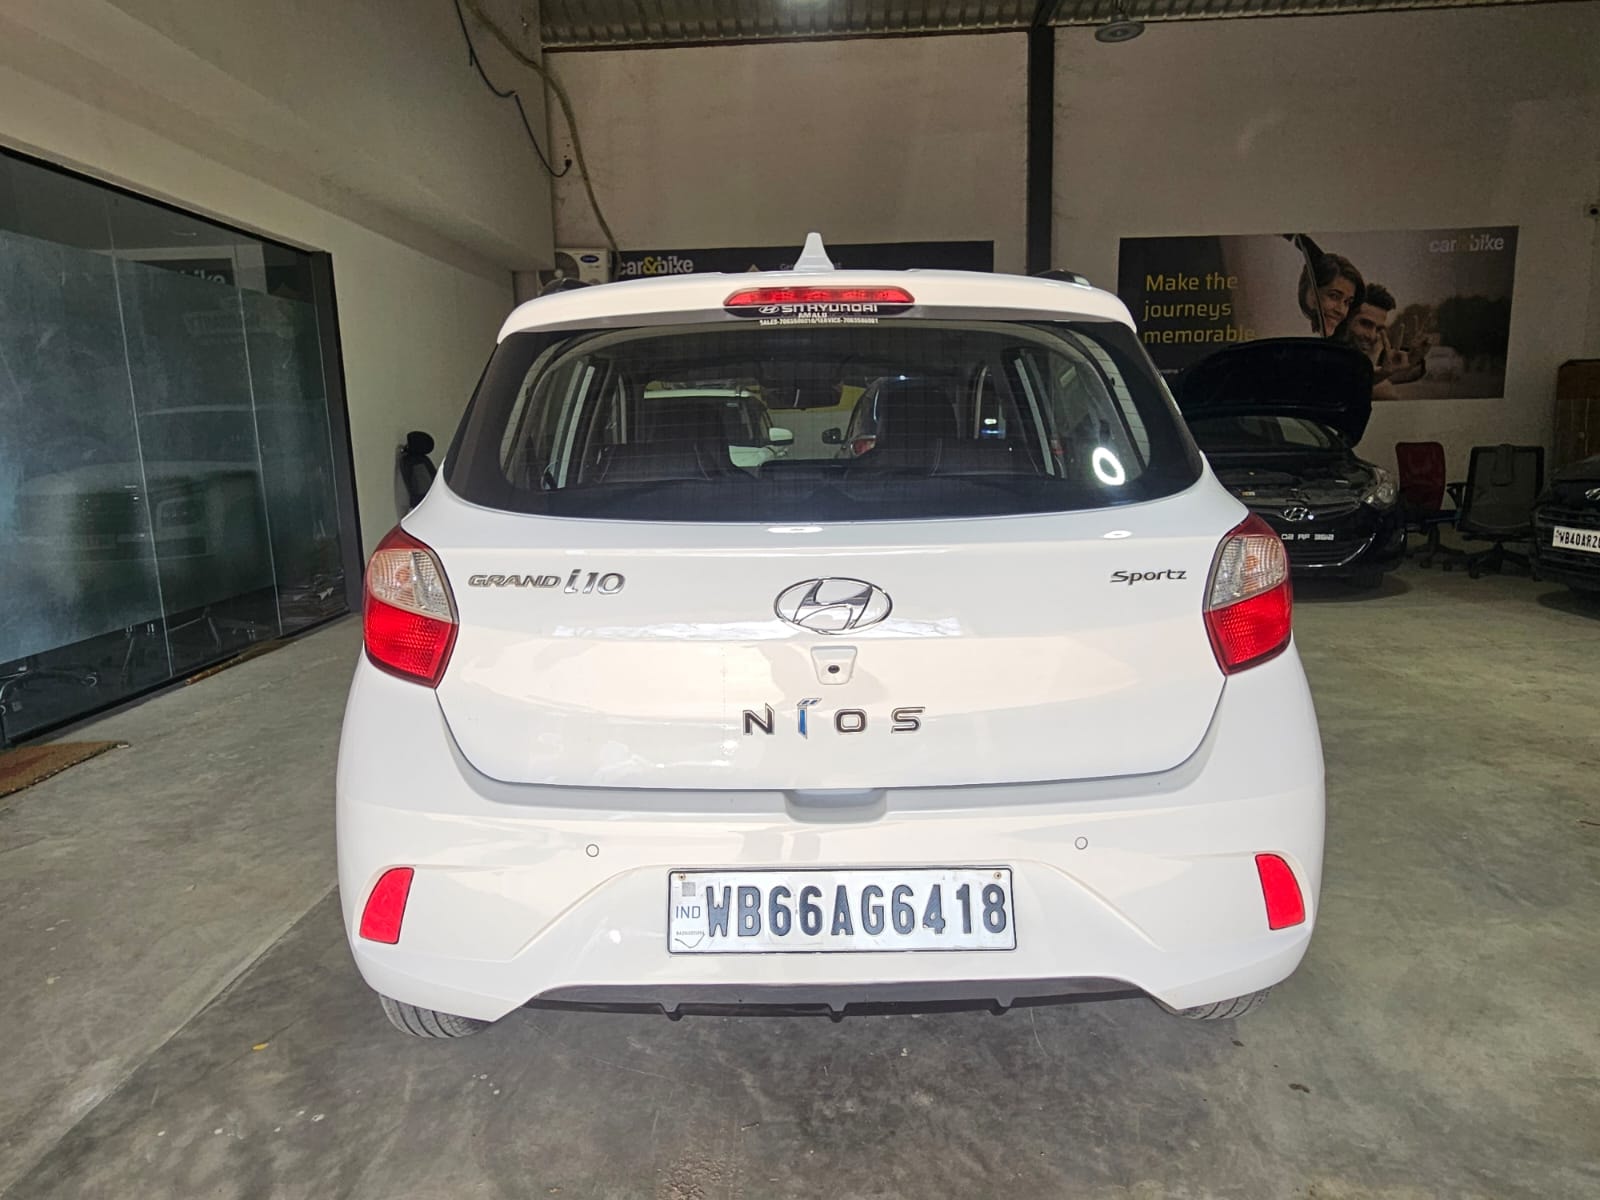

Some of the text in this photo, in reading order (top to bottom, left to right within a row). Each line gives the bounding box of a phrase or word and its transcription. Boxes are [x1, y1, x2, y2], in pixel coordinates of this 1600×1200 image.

[1428, 234, 1505, 253] carbike
[1146, 272, 1239, 291] Make the
[807, 303, 878, 312] HYUNDAI
[1143, 300, 1232, 321] journeys
[1144, 324, 1256, 343] memorable
[1559, 531, 1600, 549] WB40AR2
[468, 569, 625, 595] GRAND i10
[1110, 569, 1187, 586] Sportz
[676, 906, 701, 919] IND
[706, 884, 1007, 937] WB66AG6418
